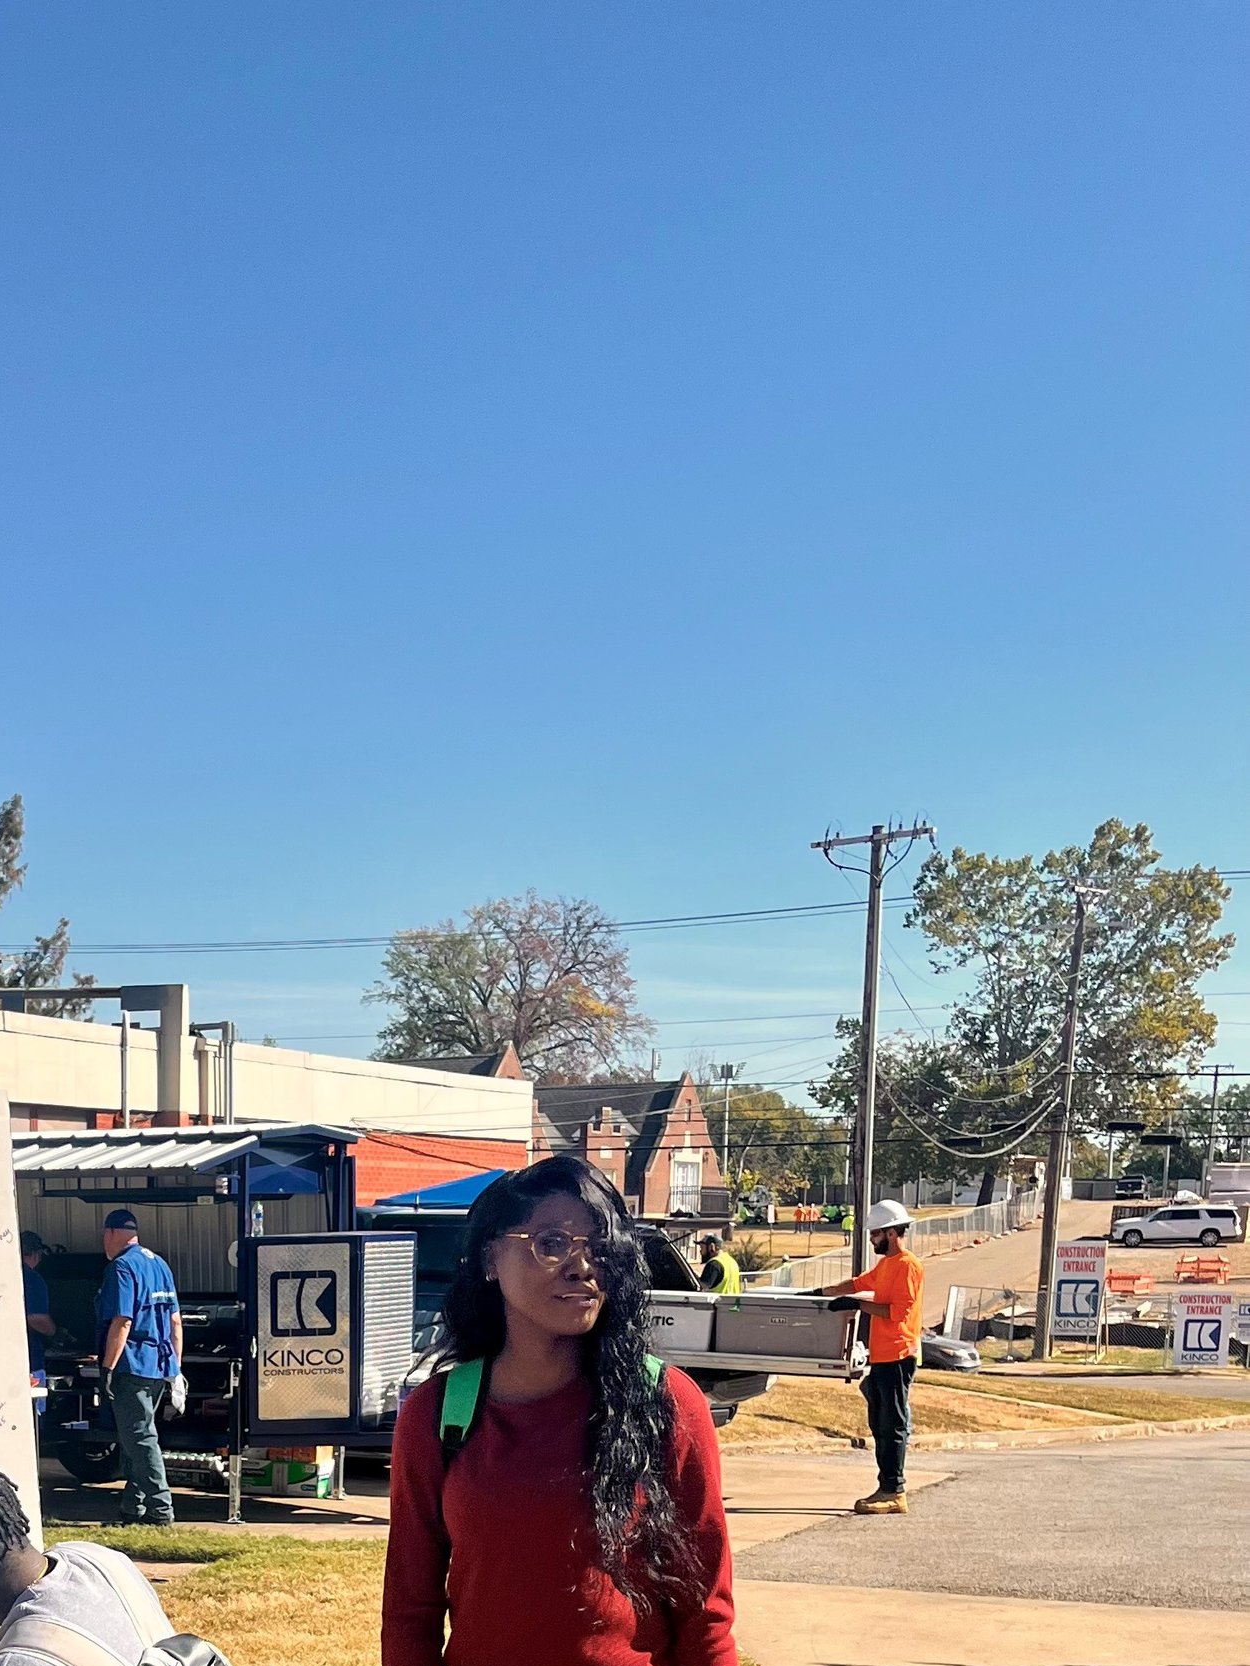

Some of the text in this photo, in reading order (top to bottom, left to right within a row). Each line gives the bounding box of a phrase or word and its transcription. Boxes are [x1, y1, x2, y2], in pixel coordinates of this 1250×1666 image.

[1057, 1246, 1106, 1259] CONSTRUCTION
[1063, 1261, 1097, 1273] ENTRANCE
[1179, 1294, 1232, 1305] CONSTRUCTION
[1186, 1305, 1223, 1316] ENTRANCE
[1054, 1319, 1098, 1329] KINCO
[263, 1348, 345, 1368] KINCO
[1181, 1353, 1220, 1362] KINCO
[263, 1367, 345, 1377] CONSTRUCTORS
